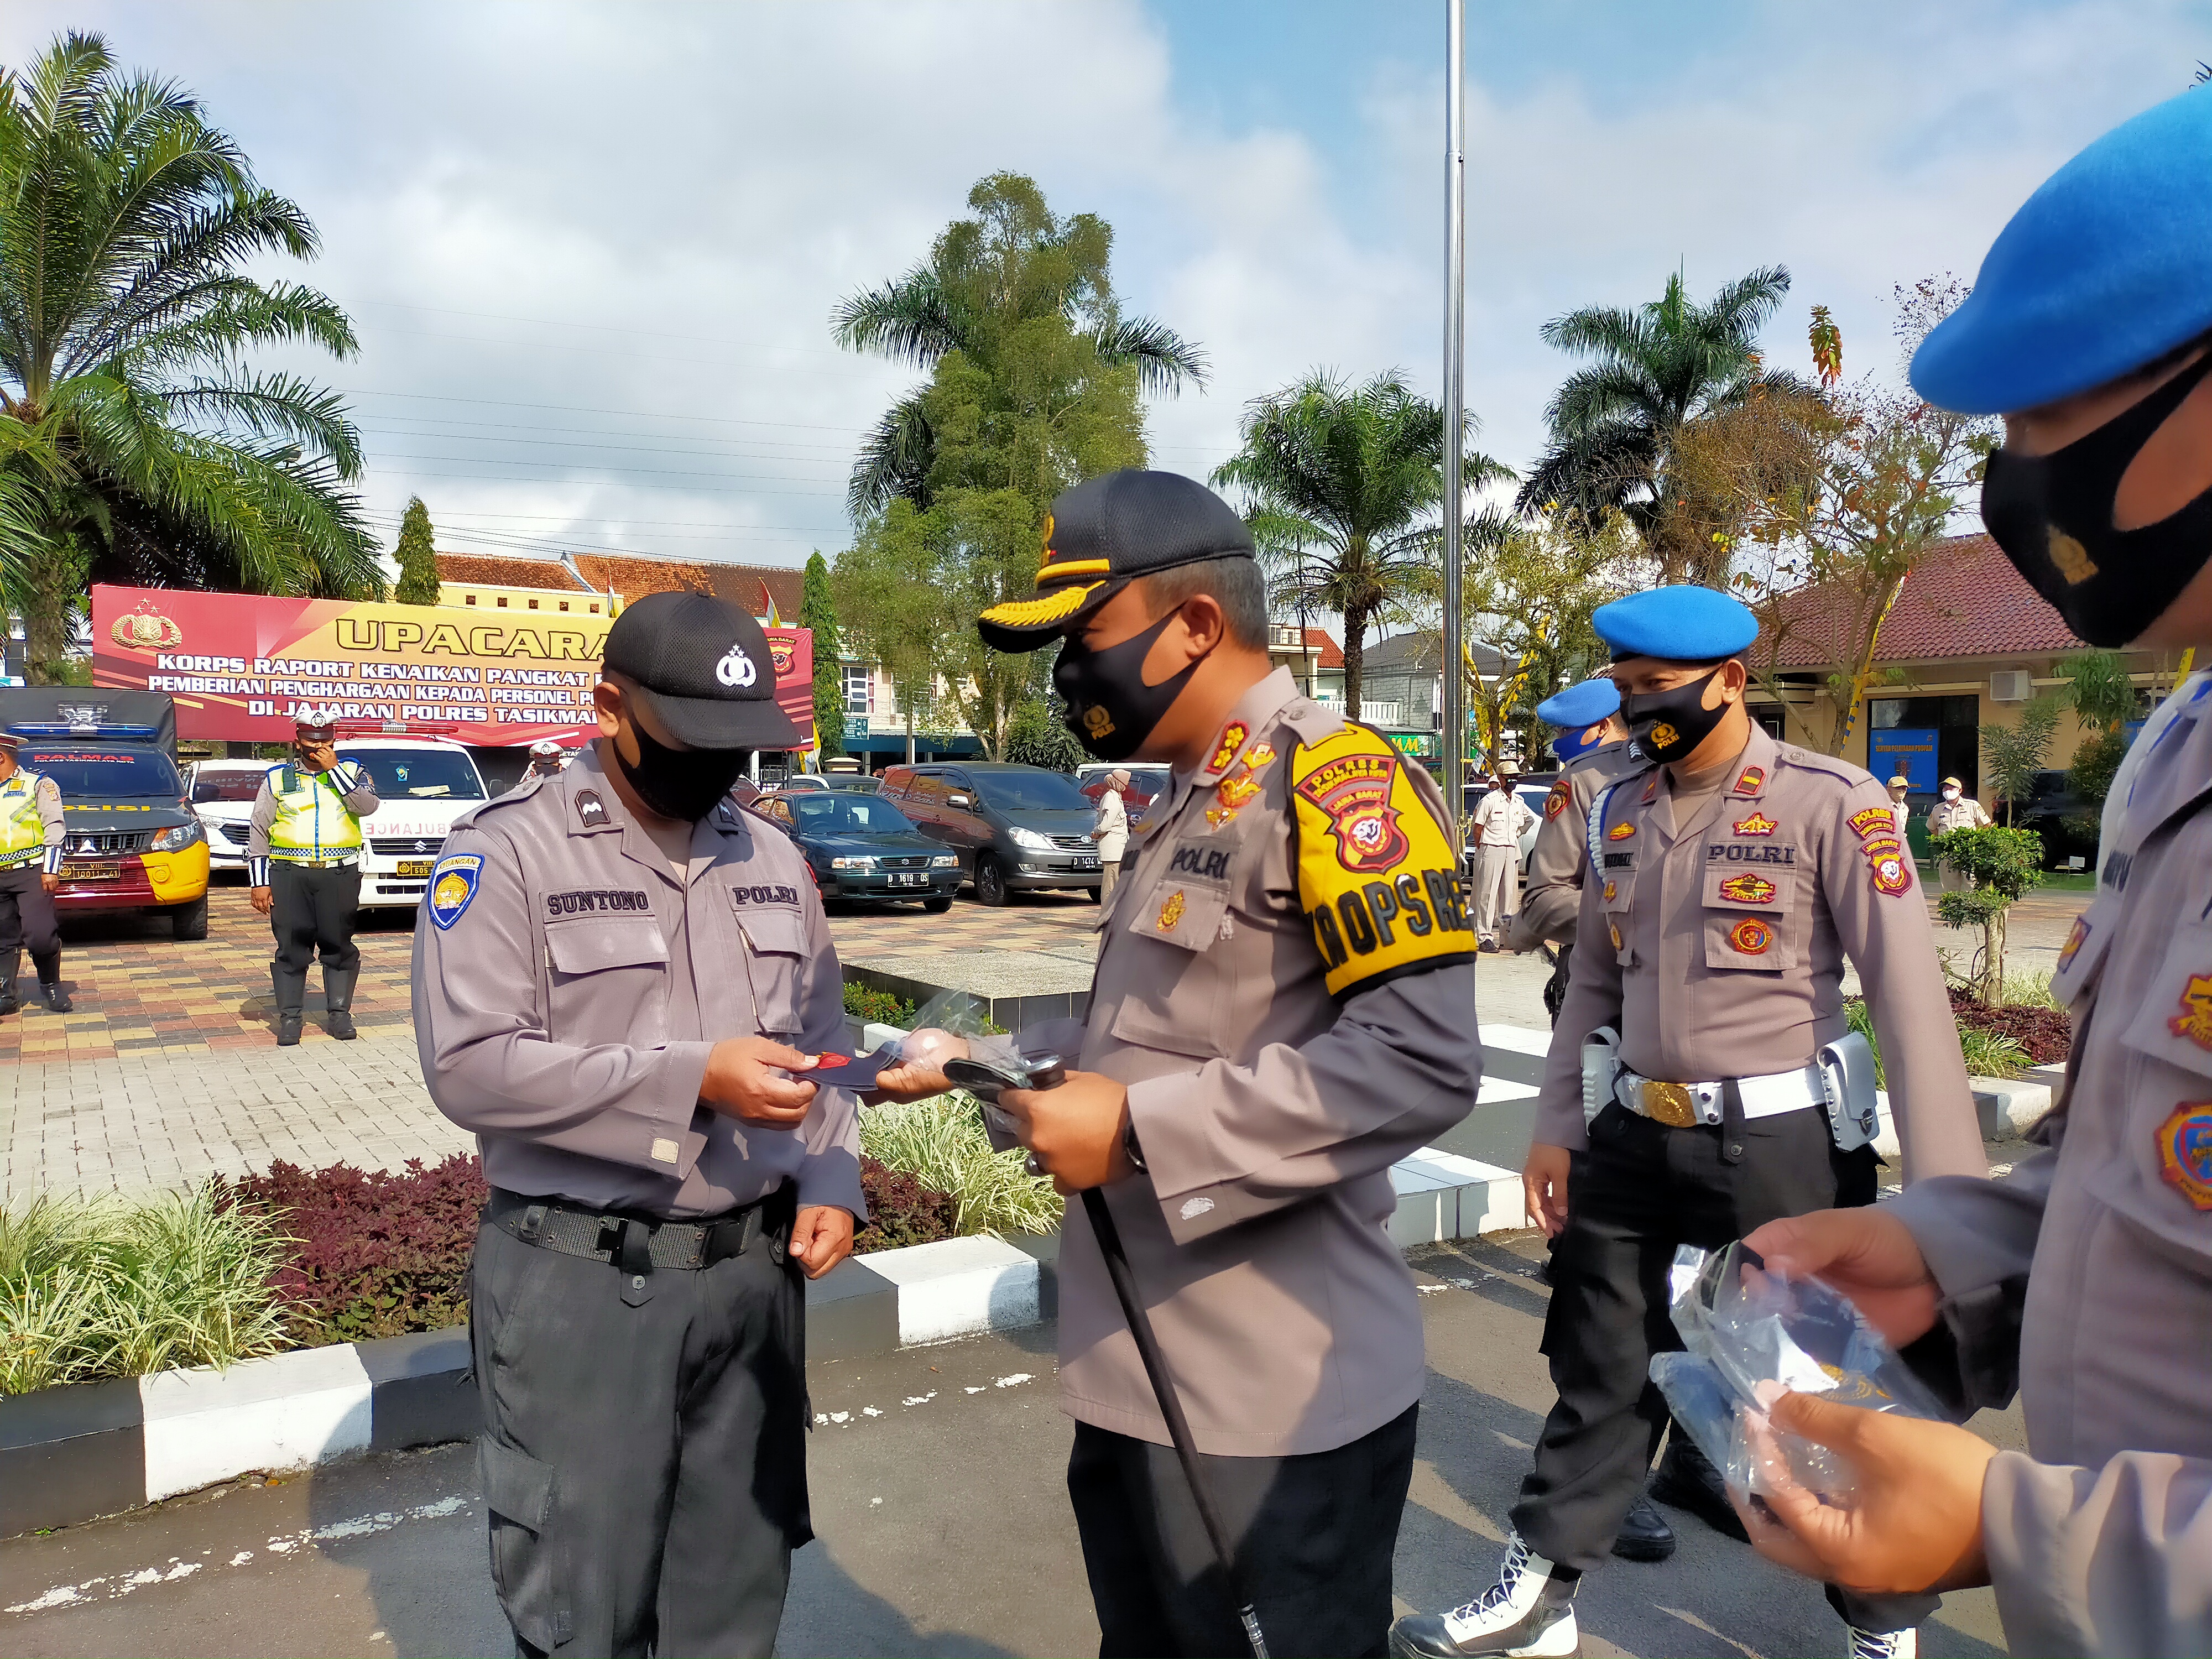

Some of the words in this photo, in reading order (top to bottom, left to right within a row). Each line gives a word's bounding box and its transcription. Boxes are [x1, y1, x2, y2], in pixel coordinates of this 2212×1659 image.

[156, 654, 246, 673] KORPS
[253, 658, 354, 677] RAPORT
[359, 662, 481, 683] KENAIKAN
[486, 668, 589, 687] PANGKAT
[148, 675, 265, 695] PEMBERIAN
[270, 680, 411, 700] PENGHARGAAN
[414, 685, 488, 702] KEPADA
[490, 688, 576, 705] PERSONEL
[248, 700, 274, 716] DI
[400, 704, 488, 722] POLRES
[1657, 733, 1680, 750] POLRI
[1311, 759, 1379, 788] POLRES
[1853, 808, 1891, 826] POLRES
[1170, 848, 1230, 879] POLRI
[1708, 845, 1795, 863] POLRI
[900, 874, 914, 883] 1619
[547, 891, 649, 915] SUNTONO
[733, 886, 800, 904] POLRI
